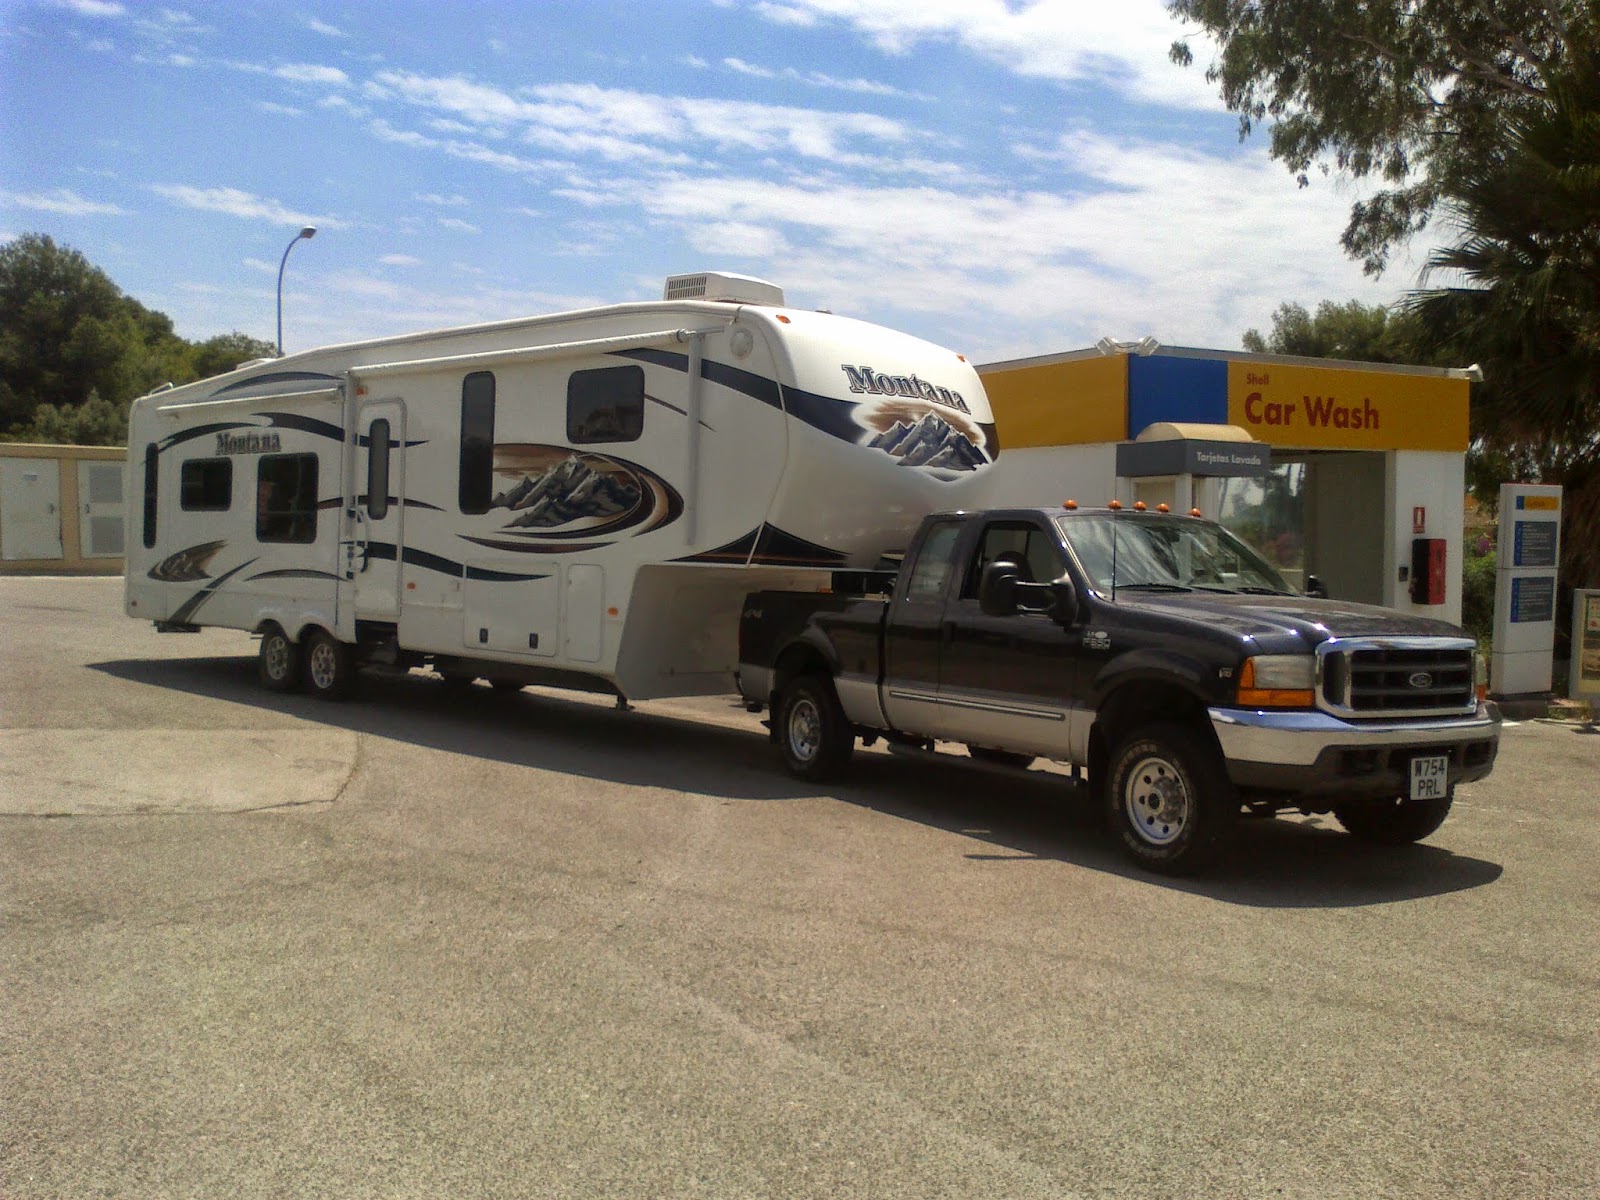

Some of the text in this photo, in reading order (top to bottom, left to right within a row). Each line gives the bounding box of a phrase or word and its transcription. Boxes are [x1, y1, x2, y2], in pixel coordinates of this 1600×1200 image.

[1246, 373, 1269, 385] Shell
[841, 364, 972, 415] Montana
[1245, 392, 1379, 429] Car Wash
[216, 431, 281, 455] Montana
[1197, 451, 1261, 465] Tarjetas Lavado
[1418, 779, 1440, 796] PRL
